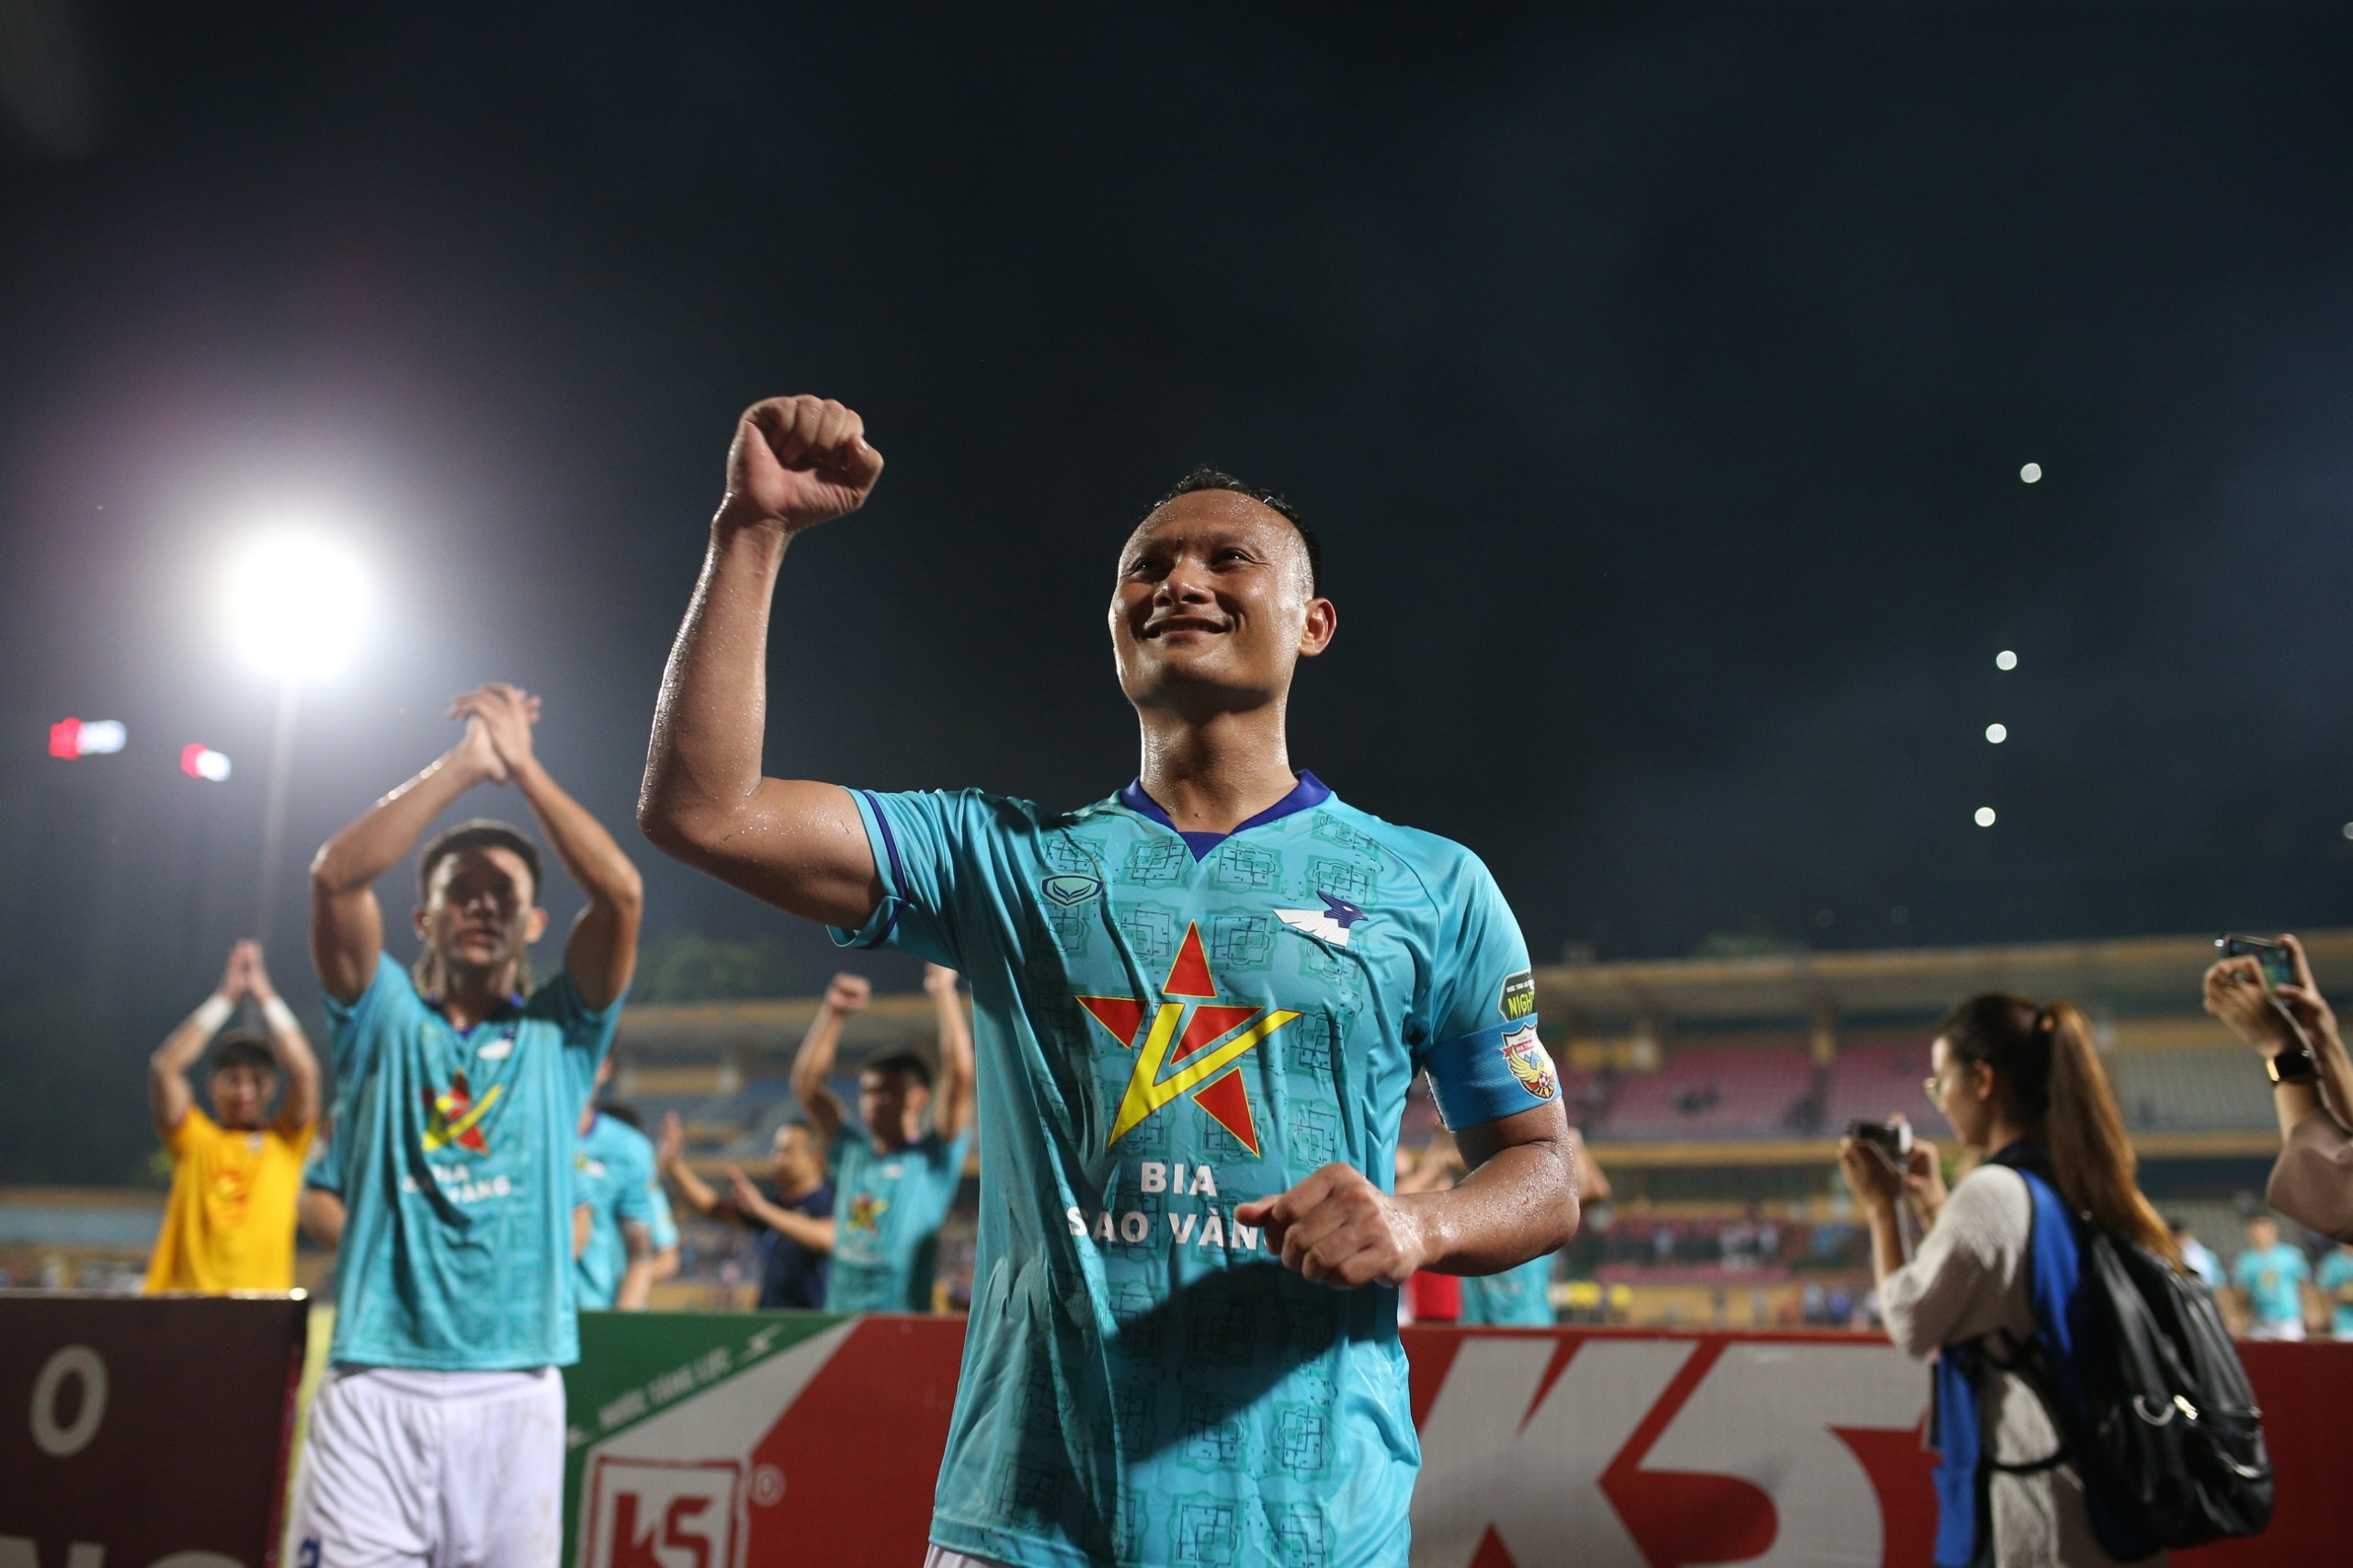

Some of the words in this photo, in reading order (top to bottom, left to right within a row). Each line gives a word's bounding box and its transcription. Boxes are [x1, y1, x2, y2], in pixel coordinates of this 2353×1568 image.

[1141, 1161, 1217, 1197] BIA
[1065, 1206, 1149, 1244] SAO
[1168, 1207, 1267, 1250] VÀN
